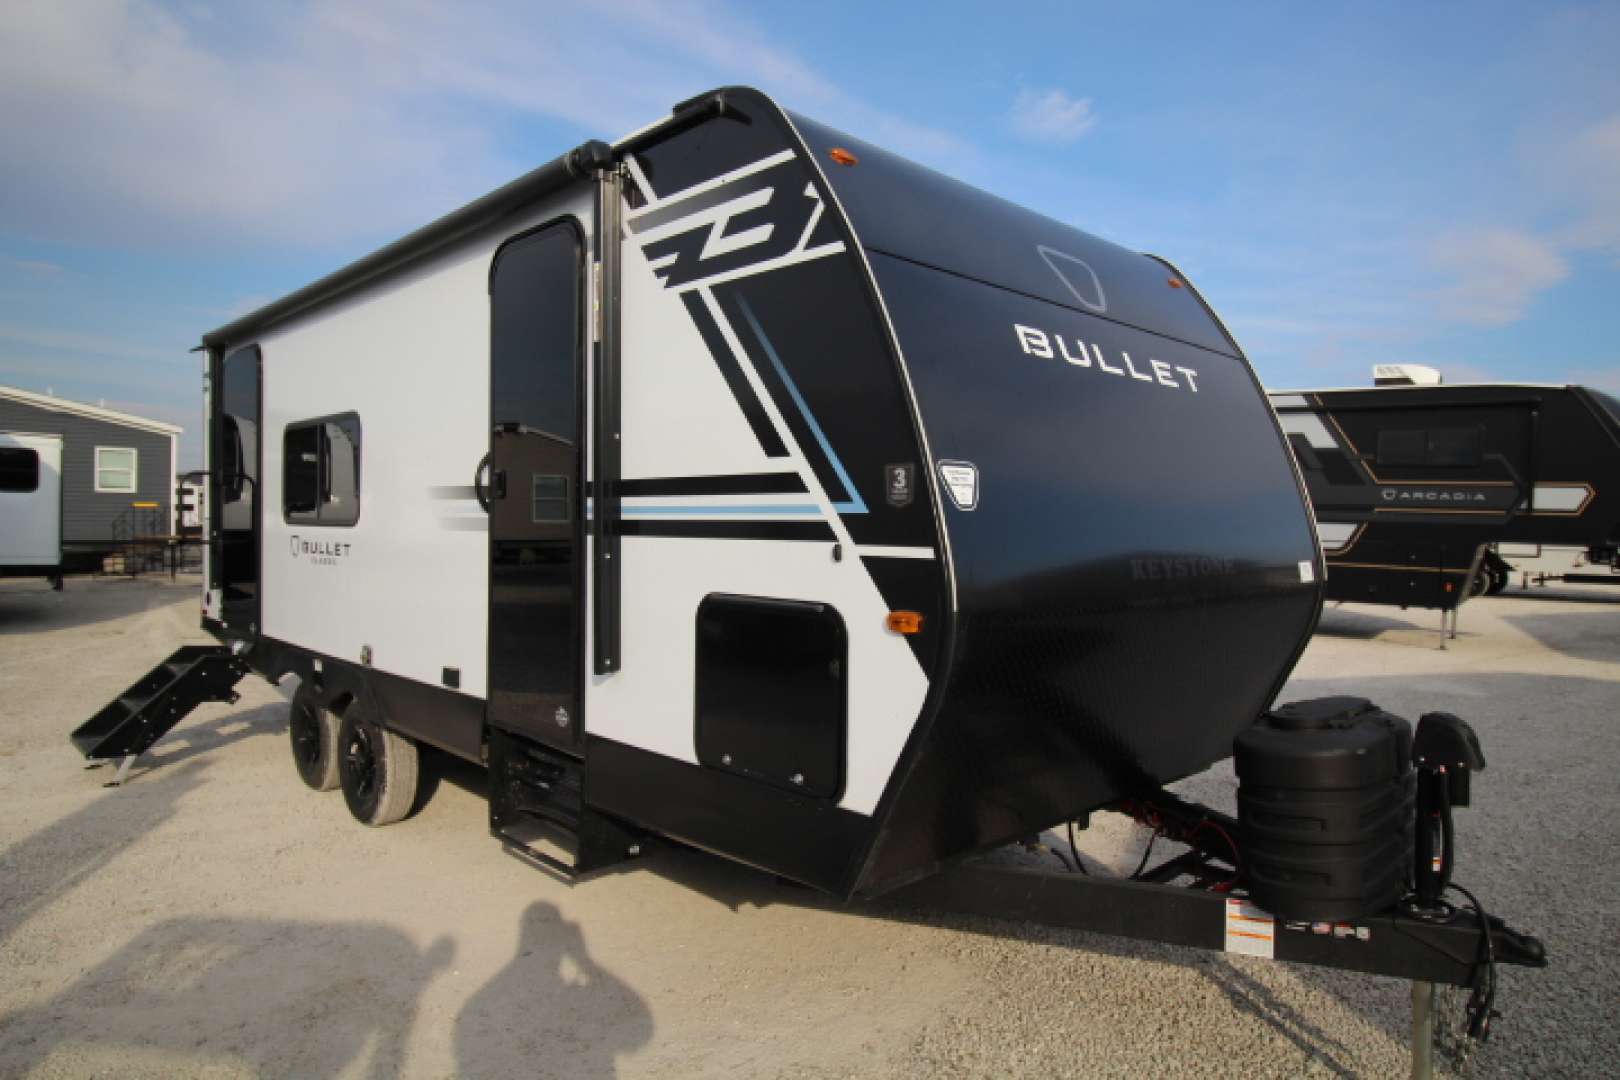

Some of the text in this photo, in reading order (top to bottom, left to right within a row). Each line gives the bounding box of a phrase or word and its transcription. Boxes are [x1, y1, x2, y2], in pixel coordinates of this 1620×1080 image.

[1014, 323, 1198, 393] BULLET
[893, 467, 906, 489] 3
[1400, 491, 1486, 501] ARCADIA
[302, 541, 351, 557] BULLET
[1130, 559, 1237, 581] KEYSTONE
